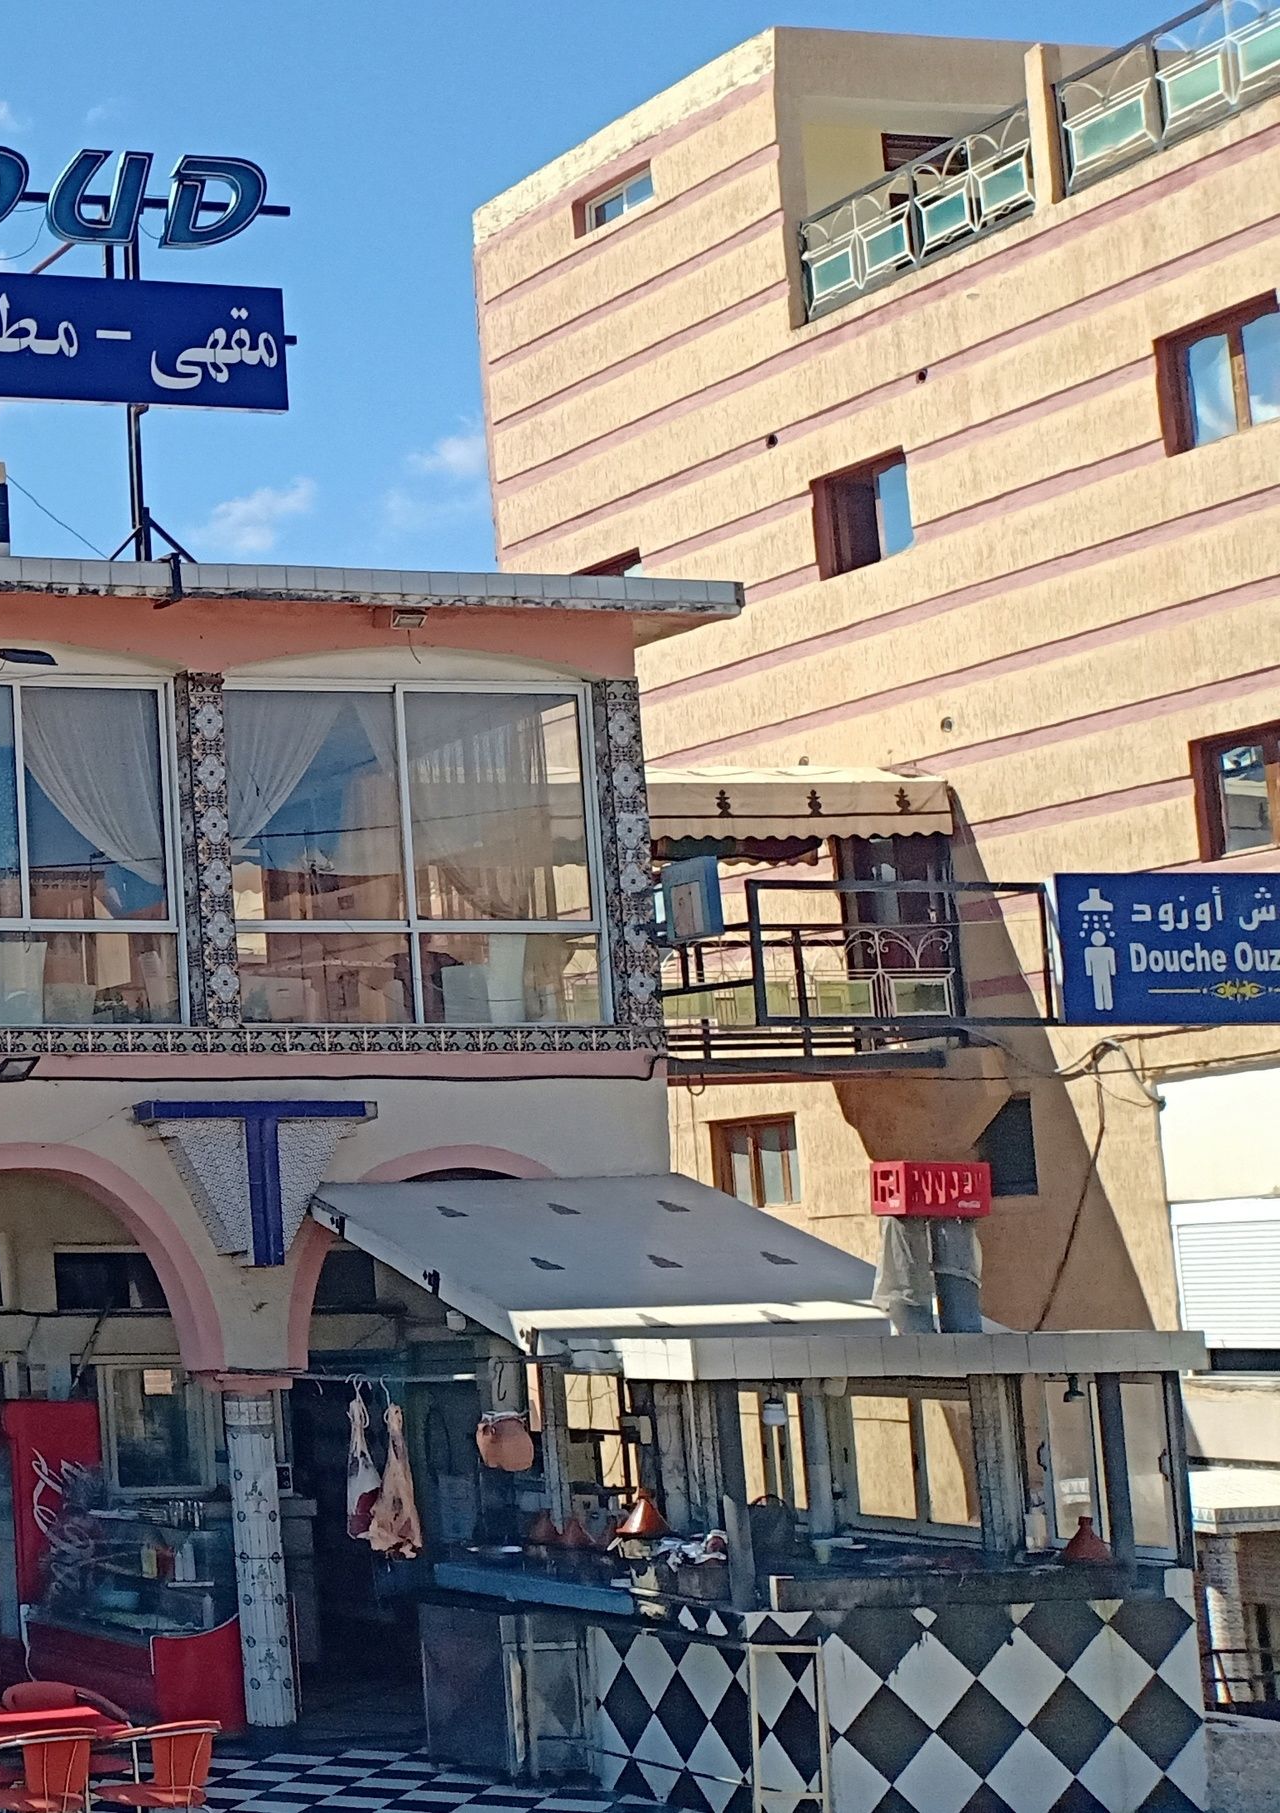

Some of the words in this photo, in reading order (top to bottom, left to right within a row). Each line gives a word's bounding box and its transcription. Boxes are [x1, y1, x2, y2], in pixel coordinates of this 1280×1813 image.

[150, 307, 278, 390] مقهى
[1131, 886, 1223, 932] أوزود
[1129, 942, 1227, 973] Douche
